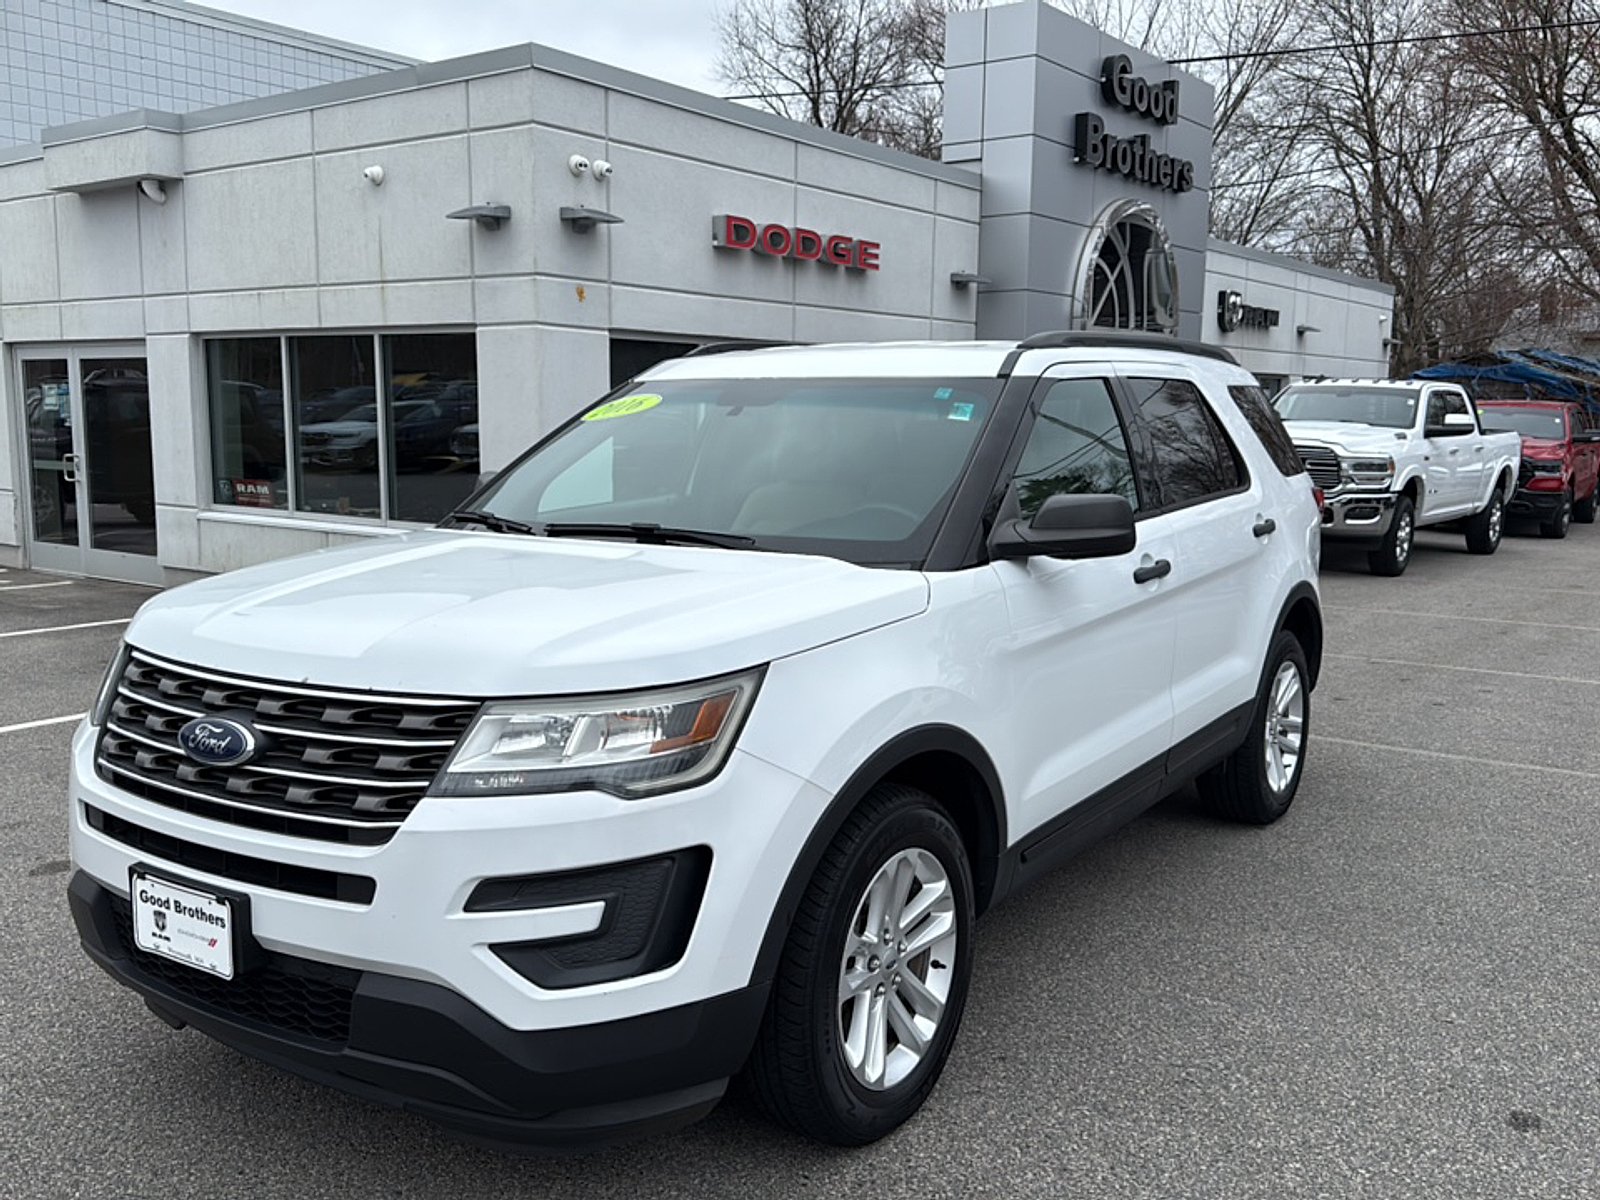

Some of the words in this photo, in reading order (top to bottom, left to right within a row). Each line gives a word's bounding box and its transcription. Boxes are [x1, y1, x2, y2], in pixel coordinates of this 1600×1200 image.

[1102, 54, 1180, 125] Good
[1075, 112, 1194, 193] Brothers
[713, 214, 881, 271] DODGE
[236, 483, 270, 495] RAM
[188, 723, 232, 754] Ford
[139, 889, 171, 911] Good
[173, 899, 226, 930] Brothers
